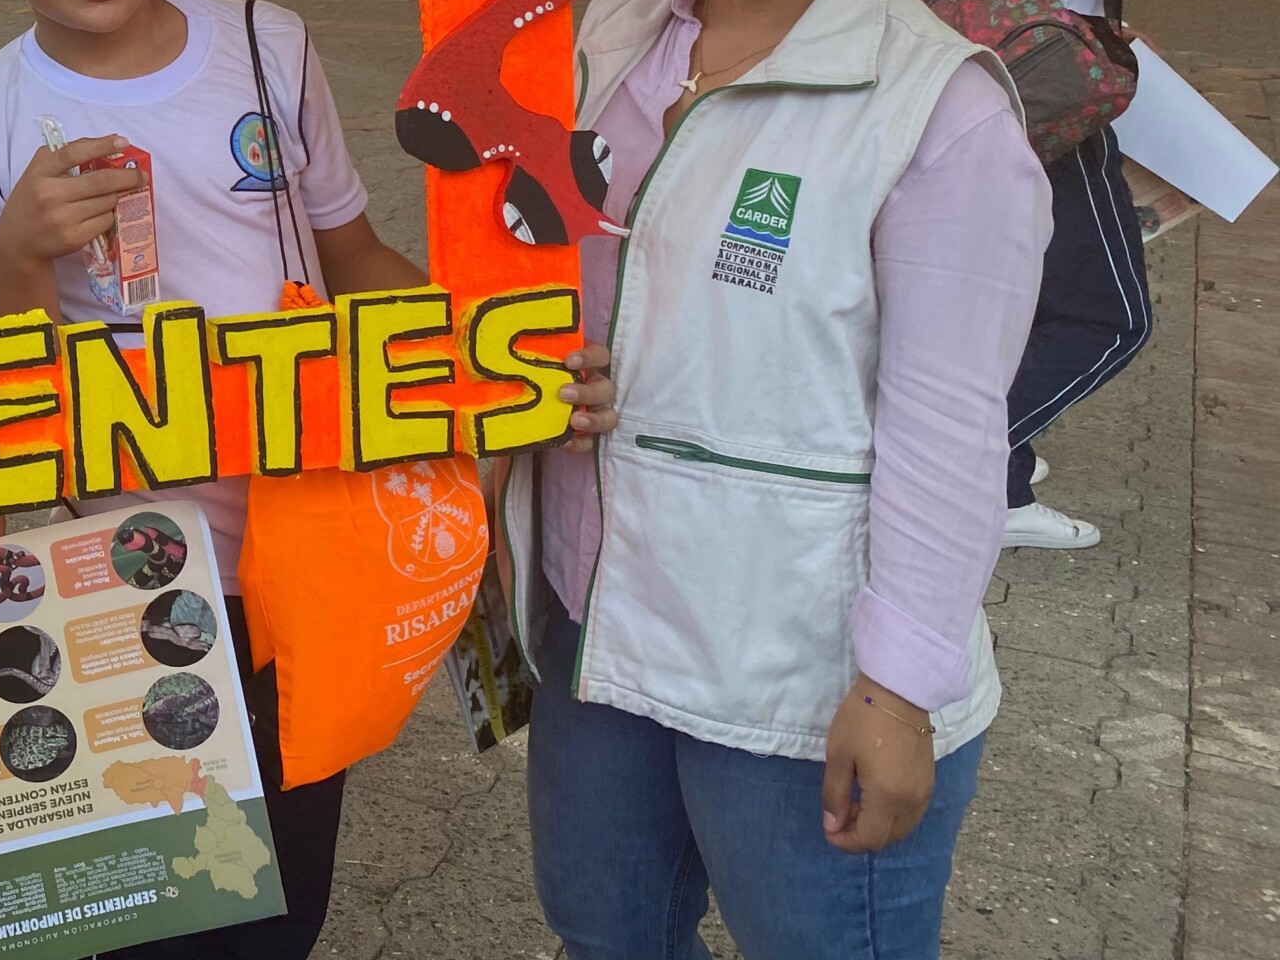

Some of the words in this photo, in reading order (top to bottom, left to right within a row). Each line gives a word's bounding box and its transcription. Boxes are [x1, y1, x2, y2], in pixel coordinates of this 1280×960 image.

[736, 208, 788, 230] CARDER
[717, 250, 778, 274] AUTONOMA
[720, 240, 784, 263] CORPORACION
[712, 272, 774, 296] RISARALDA
[714, 261, 762, 280] REGIONAL
[764, 273, 777, 284] DE
[49, 777, 88, 796] ESTÁN
[49, 789, 90, 807] NUEVE
[6, 807, 74, 831] RISARALDA
[76, 802, 93, 814] EN
[64, 906, 82, 923] DE
[82, 888, 158, 918] SERPIENTES
[63, 912, 137, 936] CORPORACIÓN
[0, 931, 58, 951] AUTÓNOMA
